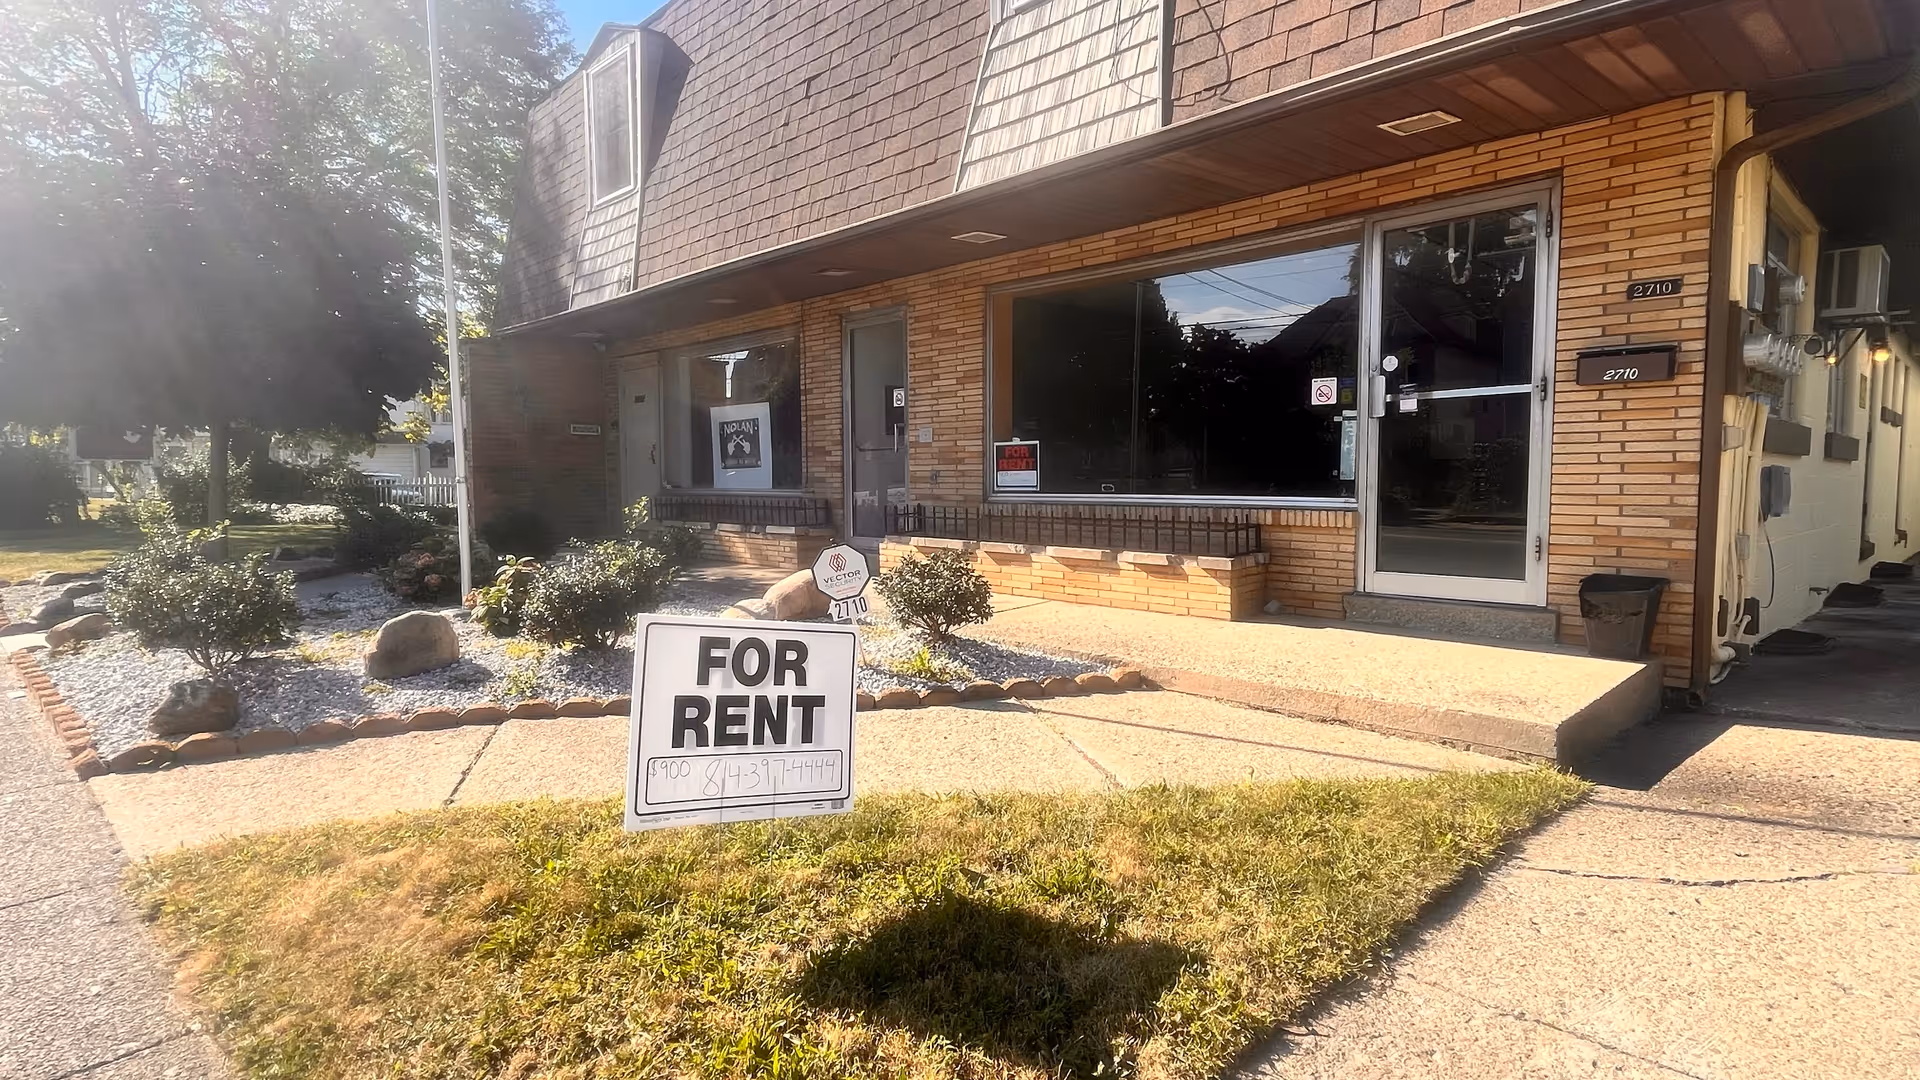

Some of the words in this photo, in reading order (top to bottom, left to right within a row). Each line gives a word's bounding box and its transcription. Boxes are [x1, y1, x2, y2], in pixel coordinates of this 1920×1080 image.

[1633, 281, 1672, 296] 2710
[1602, 367, 1639, 380] 2710
[724, 421, 753, 437] NOLAN
[1004, 445, 1029, 458] FOR
[998, 458, 1034, 469] RENT
[823, 569, 861, 584] VECTOR
[824, 576, 863, 590] SECURITY
[834, 596, 868, 619] 2710
[696, 636, 809, 687] FOR
[671, 695, 826, 749] RENT
[649, 759, 691, 780] $900
[702, 758, 836, 797] 814-397-4444
